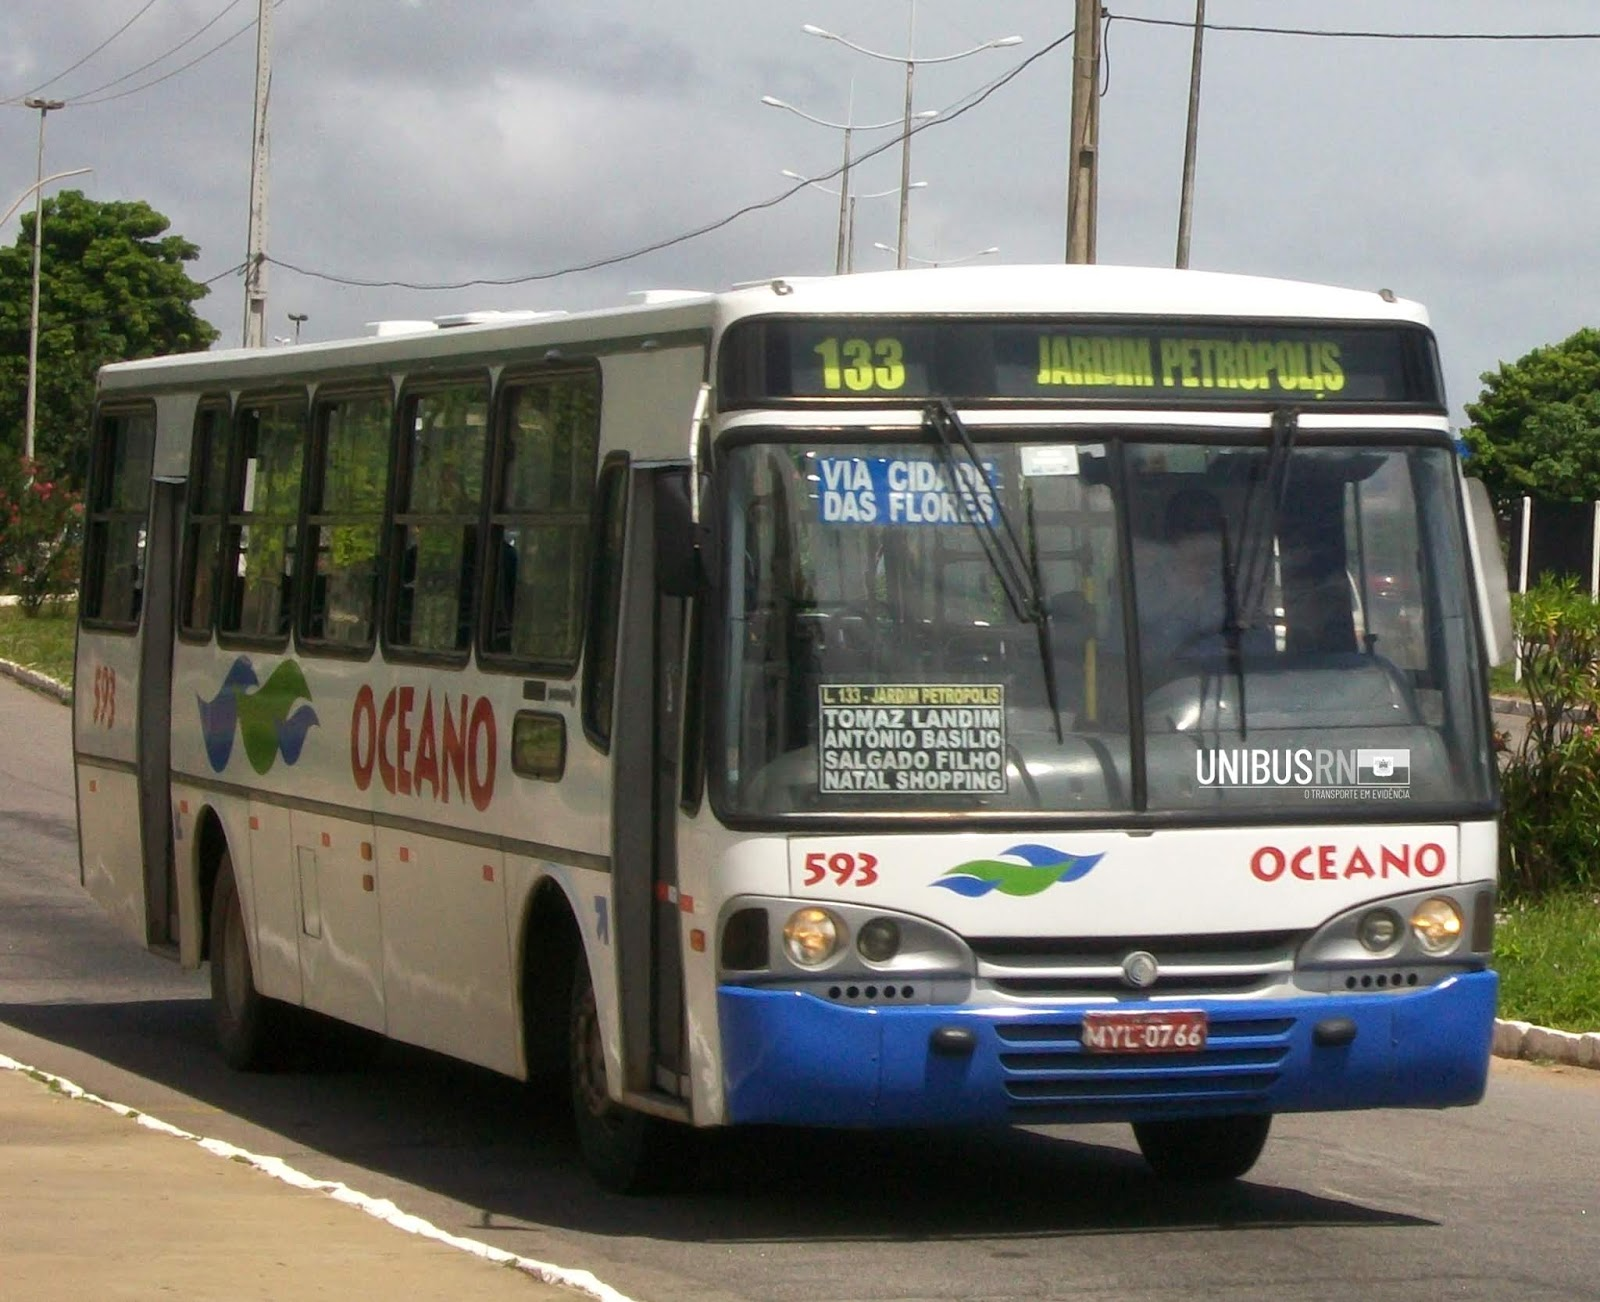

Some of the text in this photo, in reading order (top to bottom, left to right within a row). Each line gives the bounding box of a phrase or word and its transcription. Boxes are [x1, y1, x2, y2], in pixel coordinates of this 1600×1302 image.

[814, 338, 905, 390] 133
[1037, 335, 1154, 385] JARDIM
[821, 460, 874, 490] VIA
[824, 492, 877, 522] DAS
[93, 663, 117, 731] 593
[839, 687, 861, 704] 133
[871, 687, 918, 705] JARDIM
[824, 709, 1000, 728] TOMAZ LANDIM
[351, 683, 497, 812] OCEANO
[824, 751, 1000, 770] SALGADO FILHO
[824, 771, 1001, 790] NATAL SHOPPING
[804, 853, 878, 886] 593
[1251, 843, 1445, 881] OCEANO
